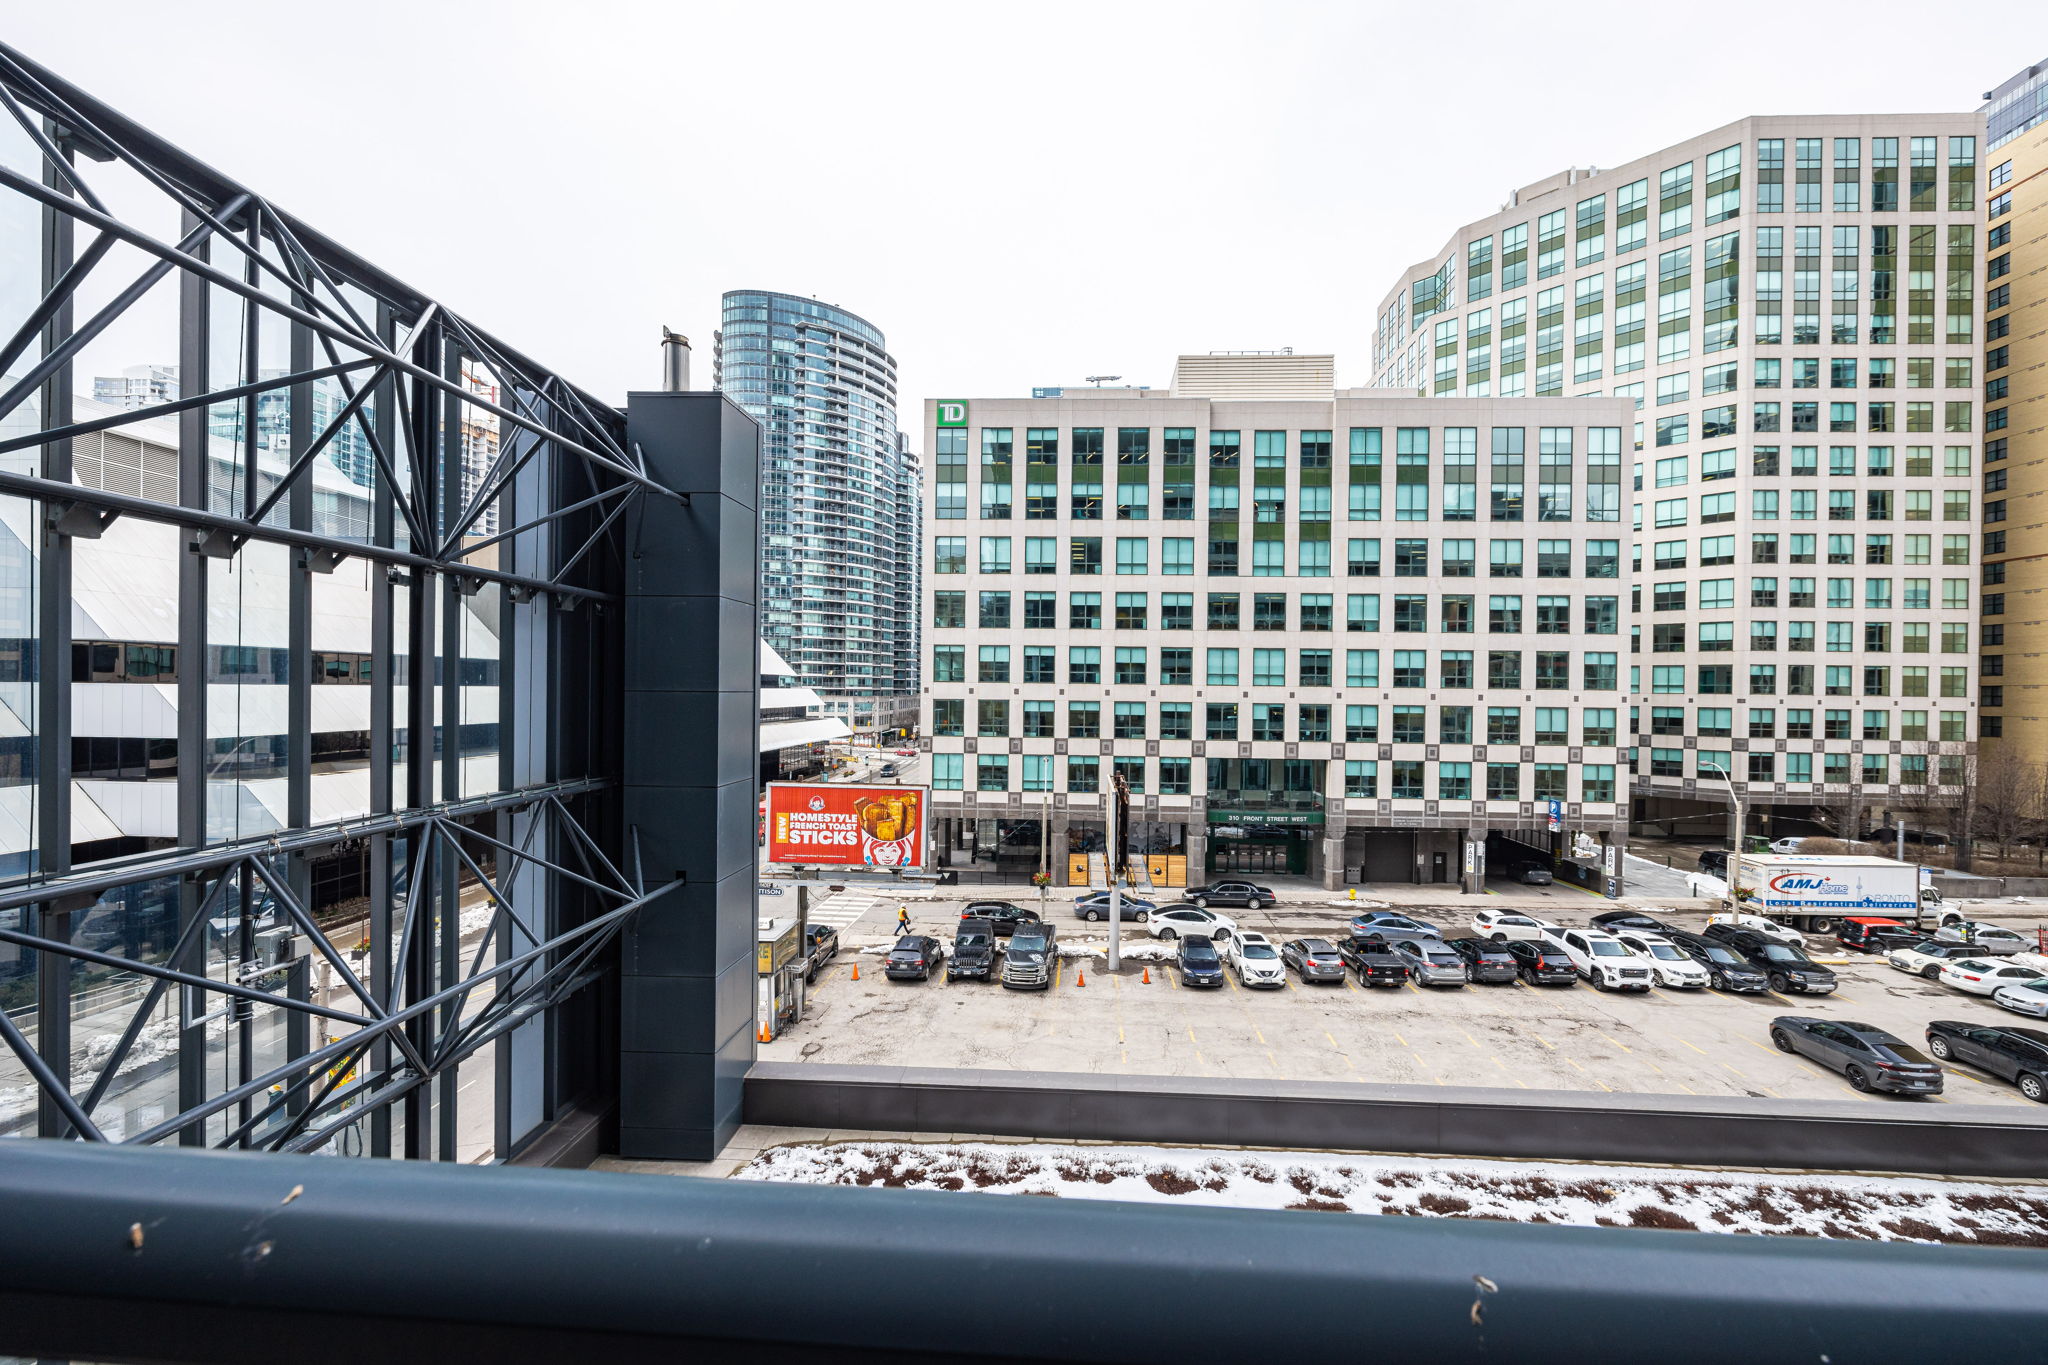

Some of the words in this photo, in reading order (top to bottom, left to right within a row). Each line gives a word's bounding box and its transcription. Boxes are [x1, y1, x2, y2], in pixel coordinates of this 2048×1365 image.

[940, 403, 965, 422] TD
[789, 813, 857, 823] HOMESTYLE
[778, 817, 786, 840] NEW
[789, 822, 826, 830] FRENCH
[789, 830, 858, 846] STICKS
[1780, 879, 1823, 889] AMJ
[1819, 882, 1849, 893] Home
